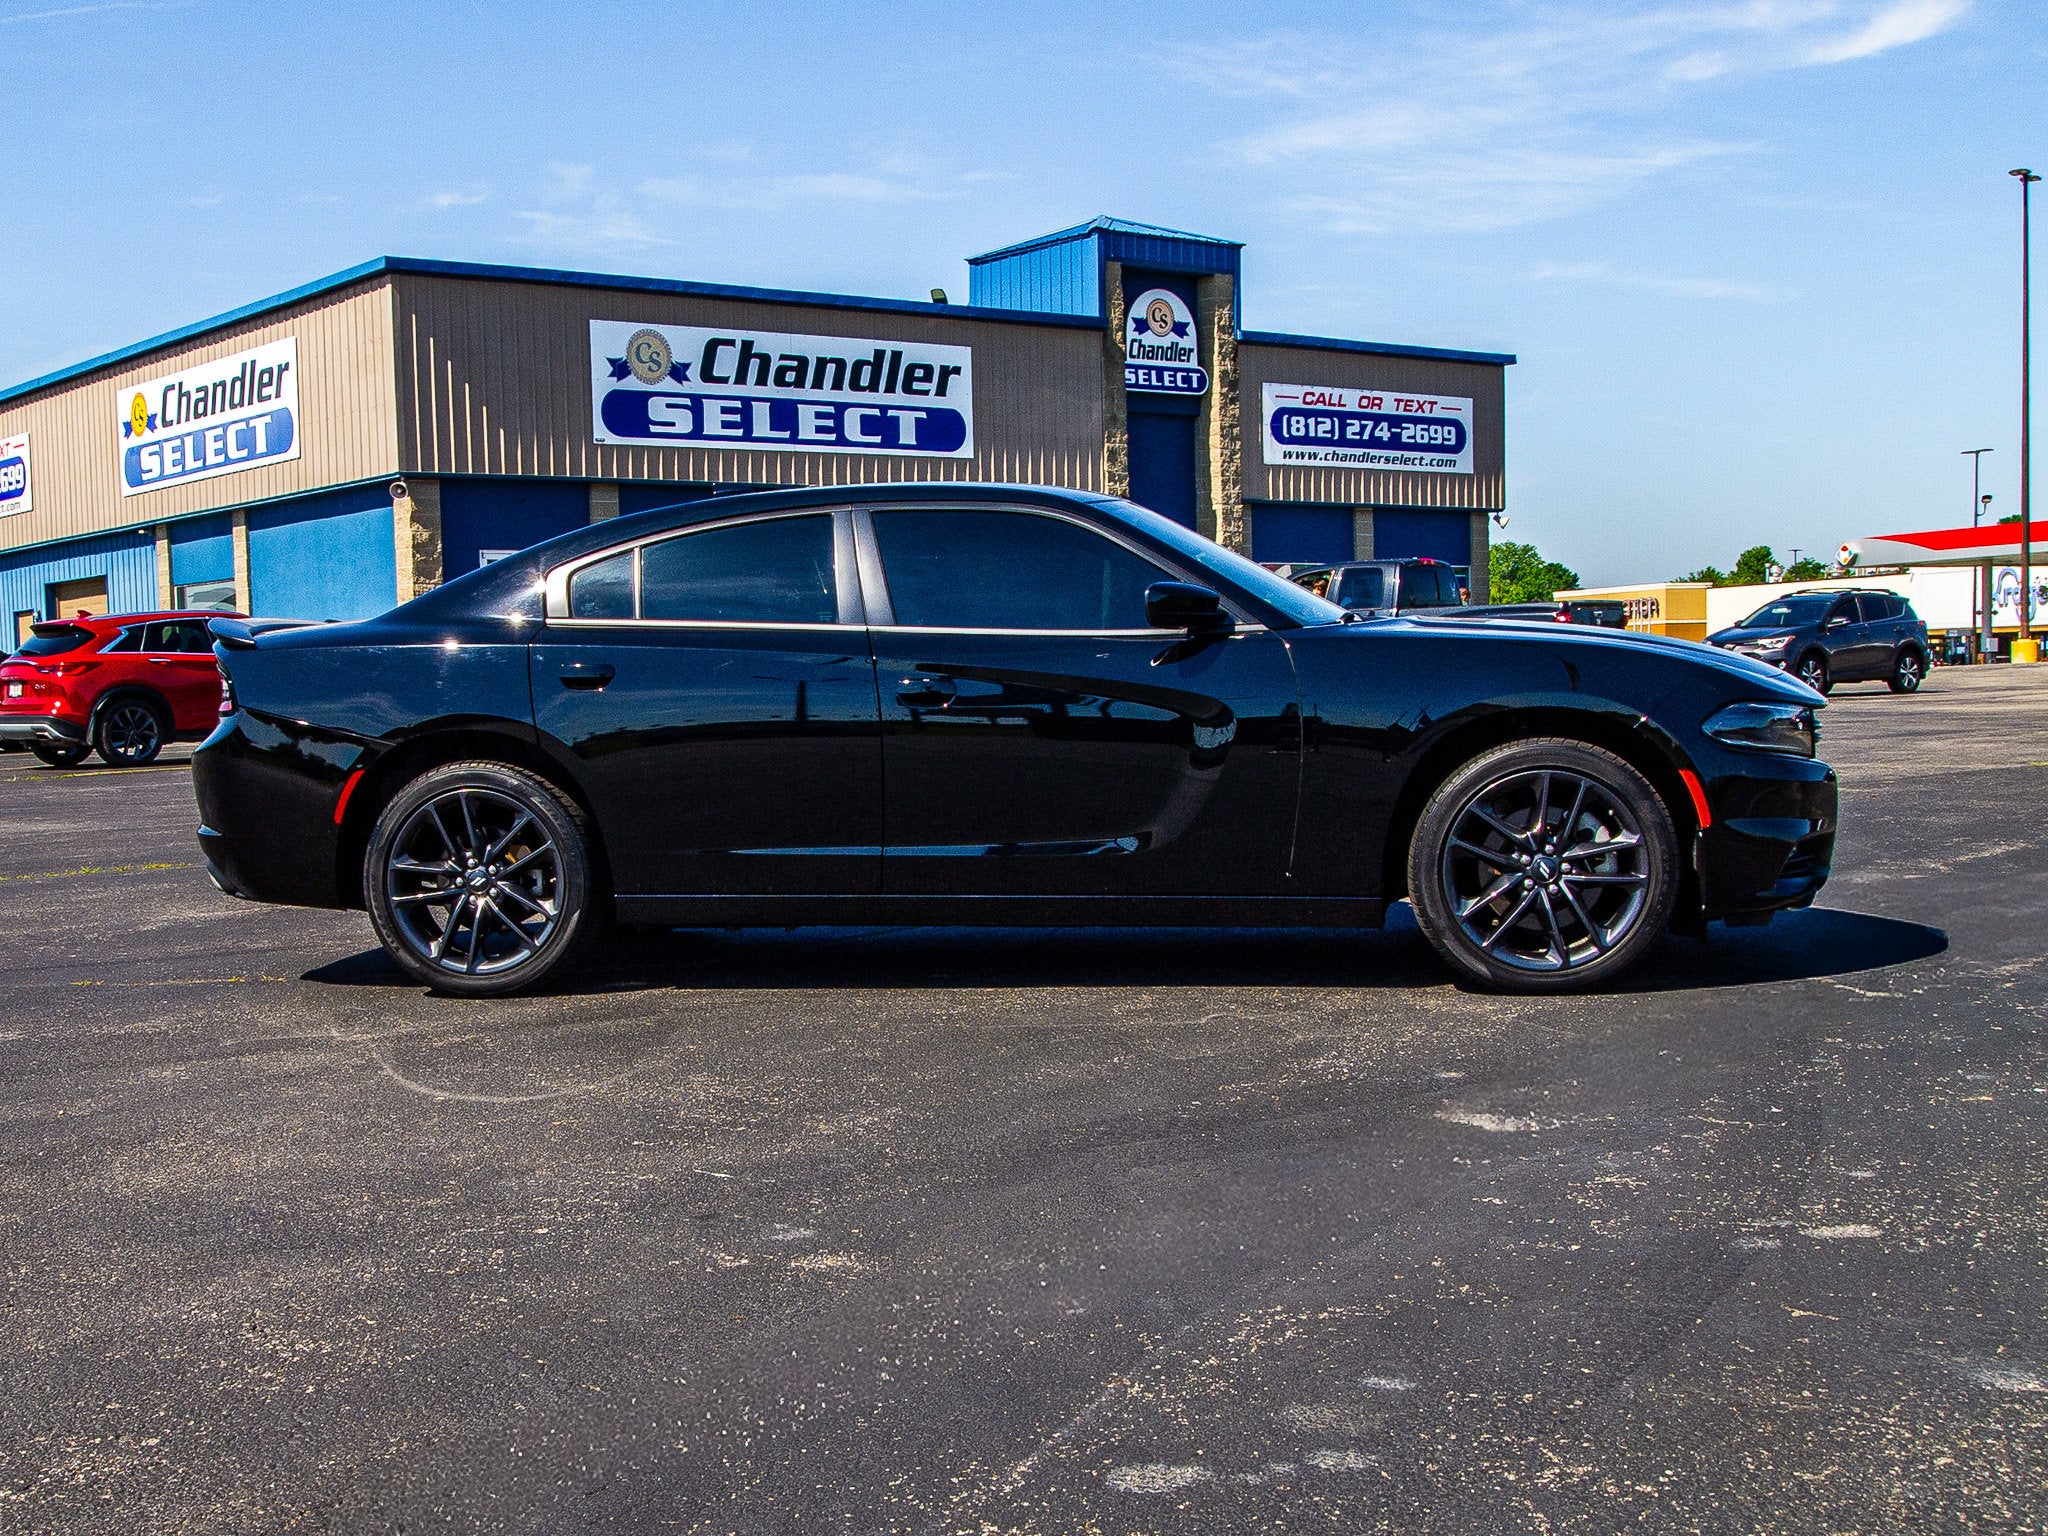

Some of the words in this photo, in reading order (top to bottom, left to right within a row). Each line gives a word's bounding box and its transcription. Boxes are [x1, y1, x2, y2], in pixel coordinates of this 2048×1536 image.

[1129, 338, 1194, 363] Chandler
[700, 337, 962, 397] Chandler
[1124, 368, 1201, 388] SELECT
[161, 359, 290, 428] Chandler
[1302, 391, 1347, 408] CALL
[1357, 395, 1384, 411] OR
[1394, 398, 1439, 414] TEXT
[647, 396, 928, 446] SELECT
[1282, 414, 1340, 440] (812)
[1346, 419, 1457, 446] 274-2699
[139, 414, 273, 482] SELECT
[1282, 450, 1457, 469] www.chandlerselect.com
[0, 463, 25, 493] 699
